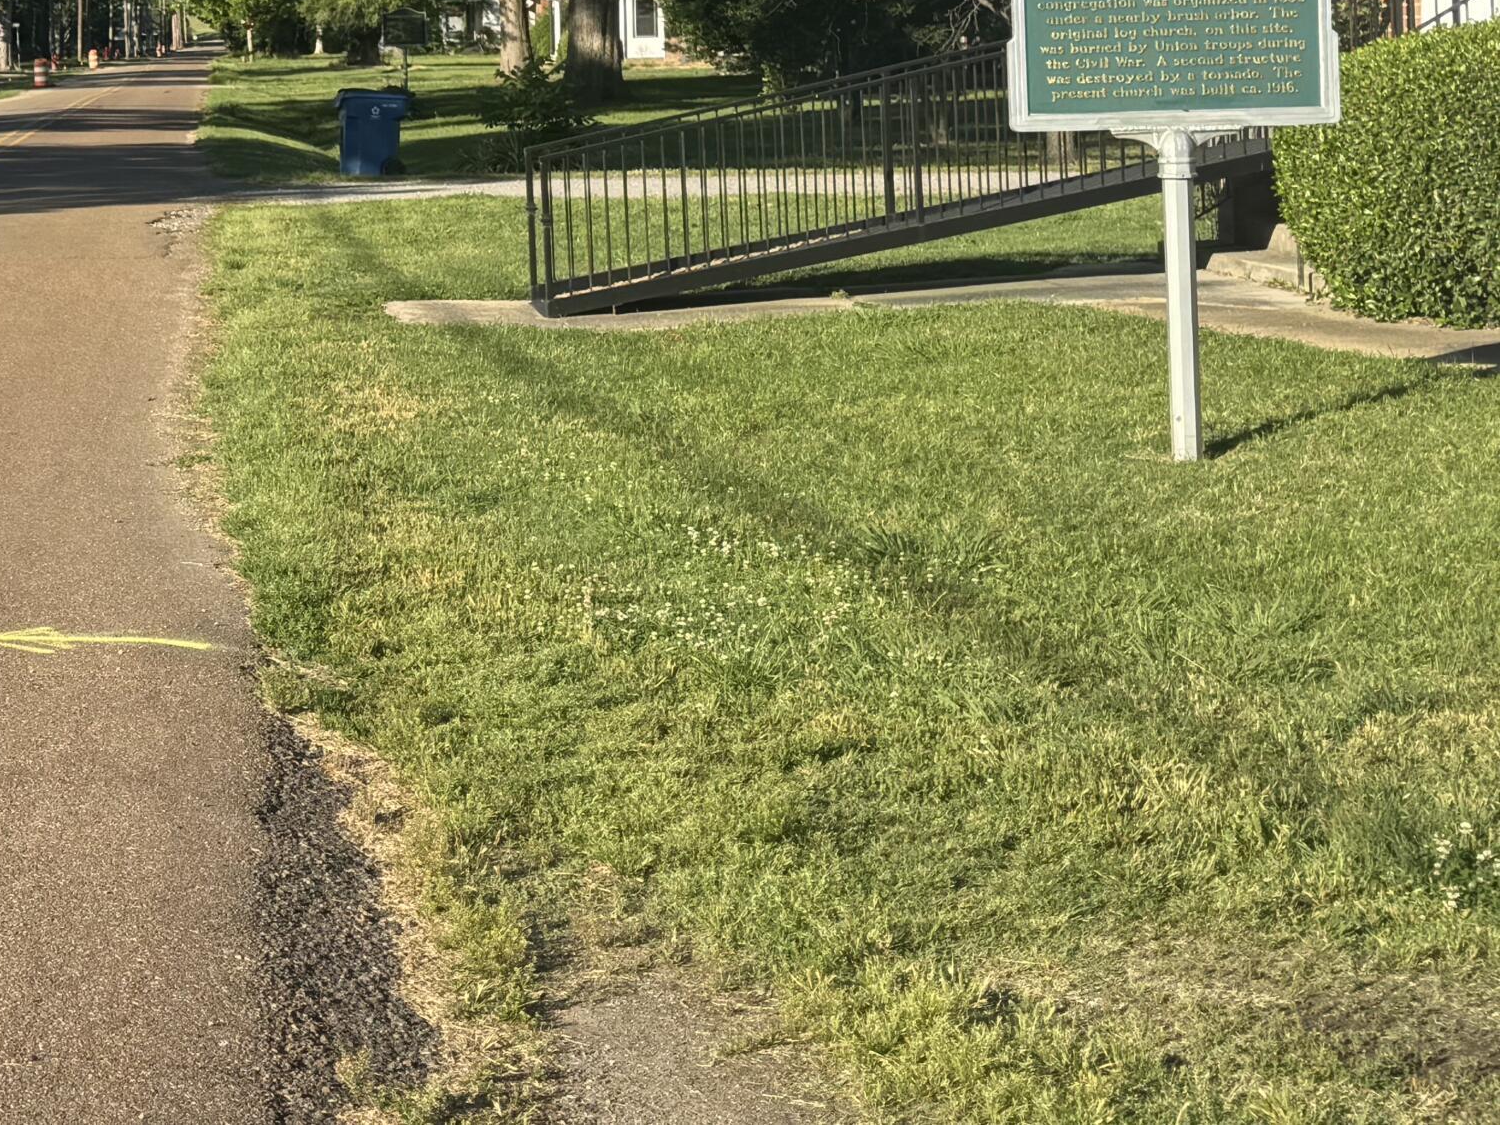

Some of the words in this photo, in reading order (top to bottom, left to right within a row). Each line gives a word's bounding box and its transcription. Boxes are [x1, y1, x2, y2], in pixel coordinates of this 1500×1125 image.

[1046, 13, 1086, 26] under
[1094, 15, 1103, 24] a
[1108, 11, 1160, 25] nearby
[1167, 9, 1209, 22] brush
[1269, 5, 1299, 19] The
[1051, 26, 1108, 43] original
[1114, 26, 1137, 41] log
[1205, 26, 1224, 36] on
[1229, 22, 1258, 35] this
[1040, 44, 1065, 55] was
[1070, 41, 1122, 55] burned
[1128, 40, 1147, 54] by
[1155, 39, 1198, 53] Union
[1204, 38, 1253, 52] troops
[1258, 36, 1306, 50] during
[1046, 57, 1071, 70] the
[1075, 55, 1109, 70] Civil
[1115, 55, 1146, 69] War.
[1156, 55, 1167, 68] A
[1173, 53, 1224, 67] second
[1229, 52, 1301, 66] structure
[1046, 74, 1071, 86] was
[1076, 71, 1154, 86] destroyed
[1272, 65, 1302, 80] The
[1052, 86, 1108, 104] present
[1113, 84, 1163, 99] church
[1170, 86, 1196, 97] was
[1202, 82, 1235, 96] built
[1241, 84, 1262, 95] ca.
